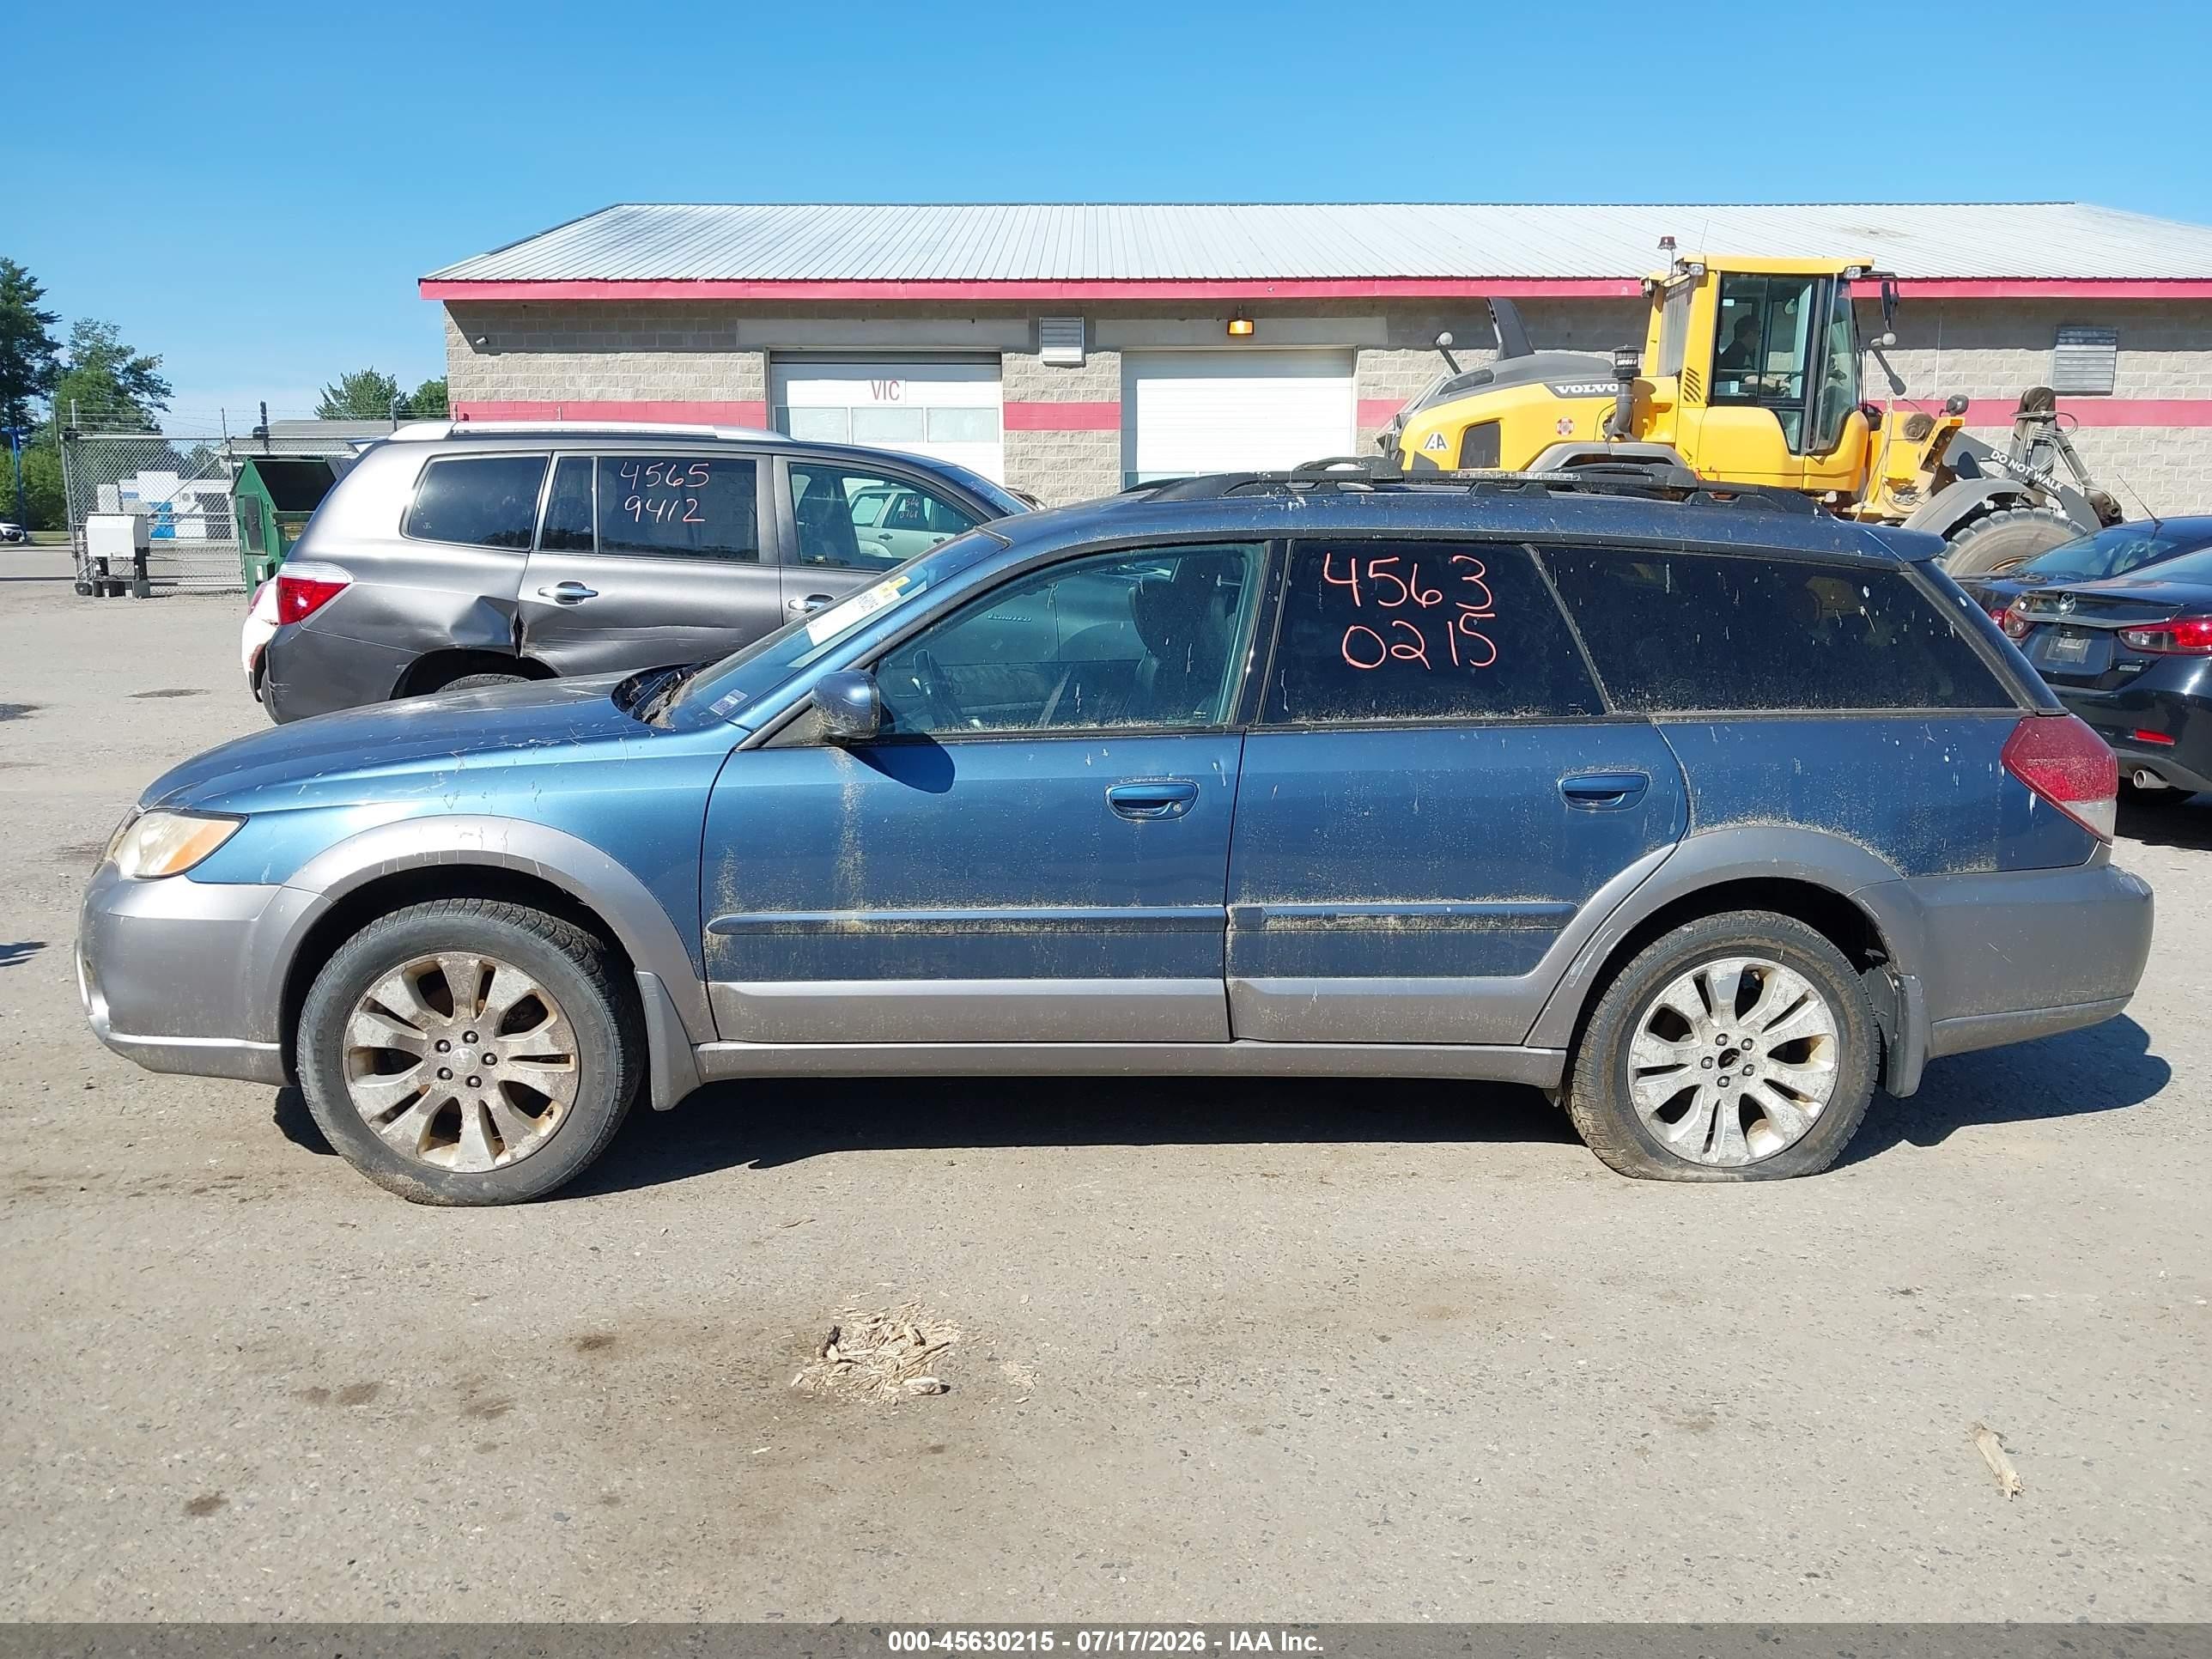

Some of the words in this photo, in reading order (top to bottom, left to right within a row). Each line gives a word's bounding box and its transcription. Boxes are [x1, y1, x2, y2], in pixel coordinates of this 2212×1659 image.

[871, 380, 900, 401] VIC
[1555, 383, 1619, 394] VOLVO
[620, 462, 709, 490] 4565
[1990, 450, 2008, 464] DO
[2008, 459, 2033, 477] NOT
[2033, 471, 2064, 492] WALK
[624, 495, 706, 524] 9412
[1323, 552, 1492, 611] 4563
[1341, 611, 1497, 671] 0215
